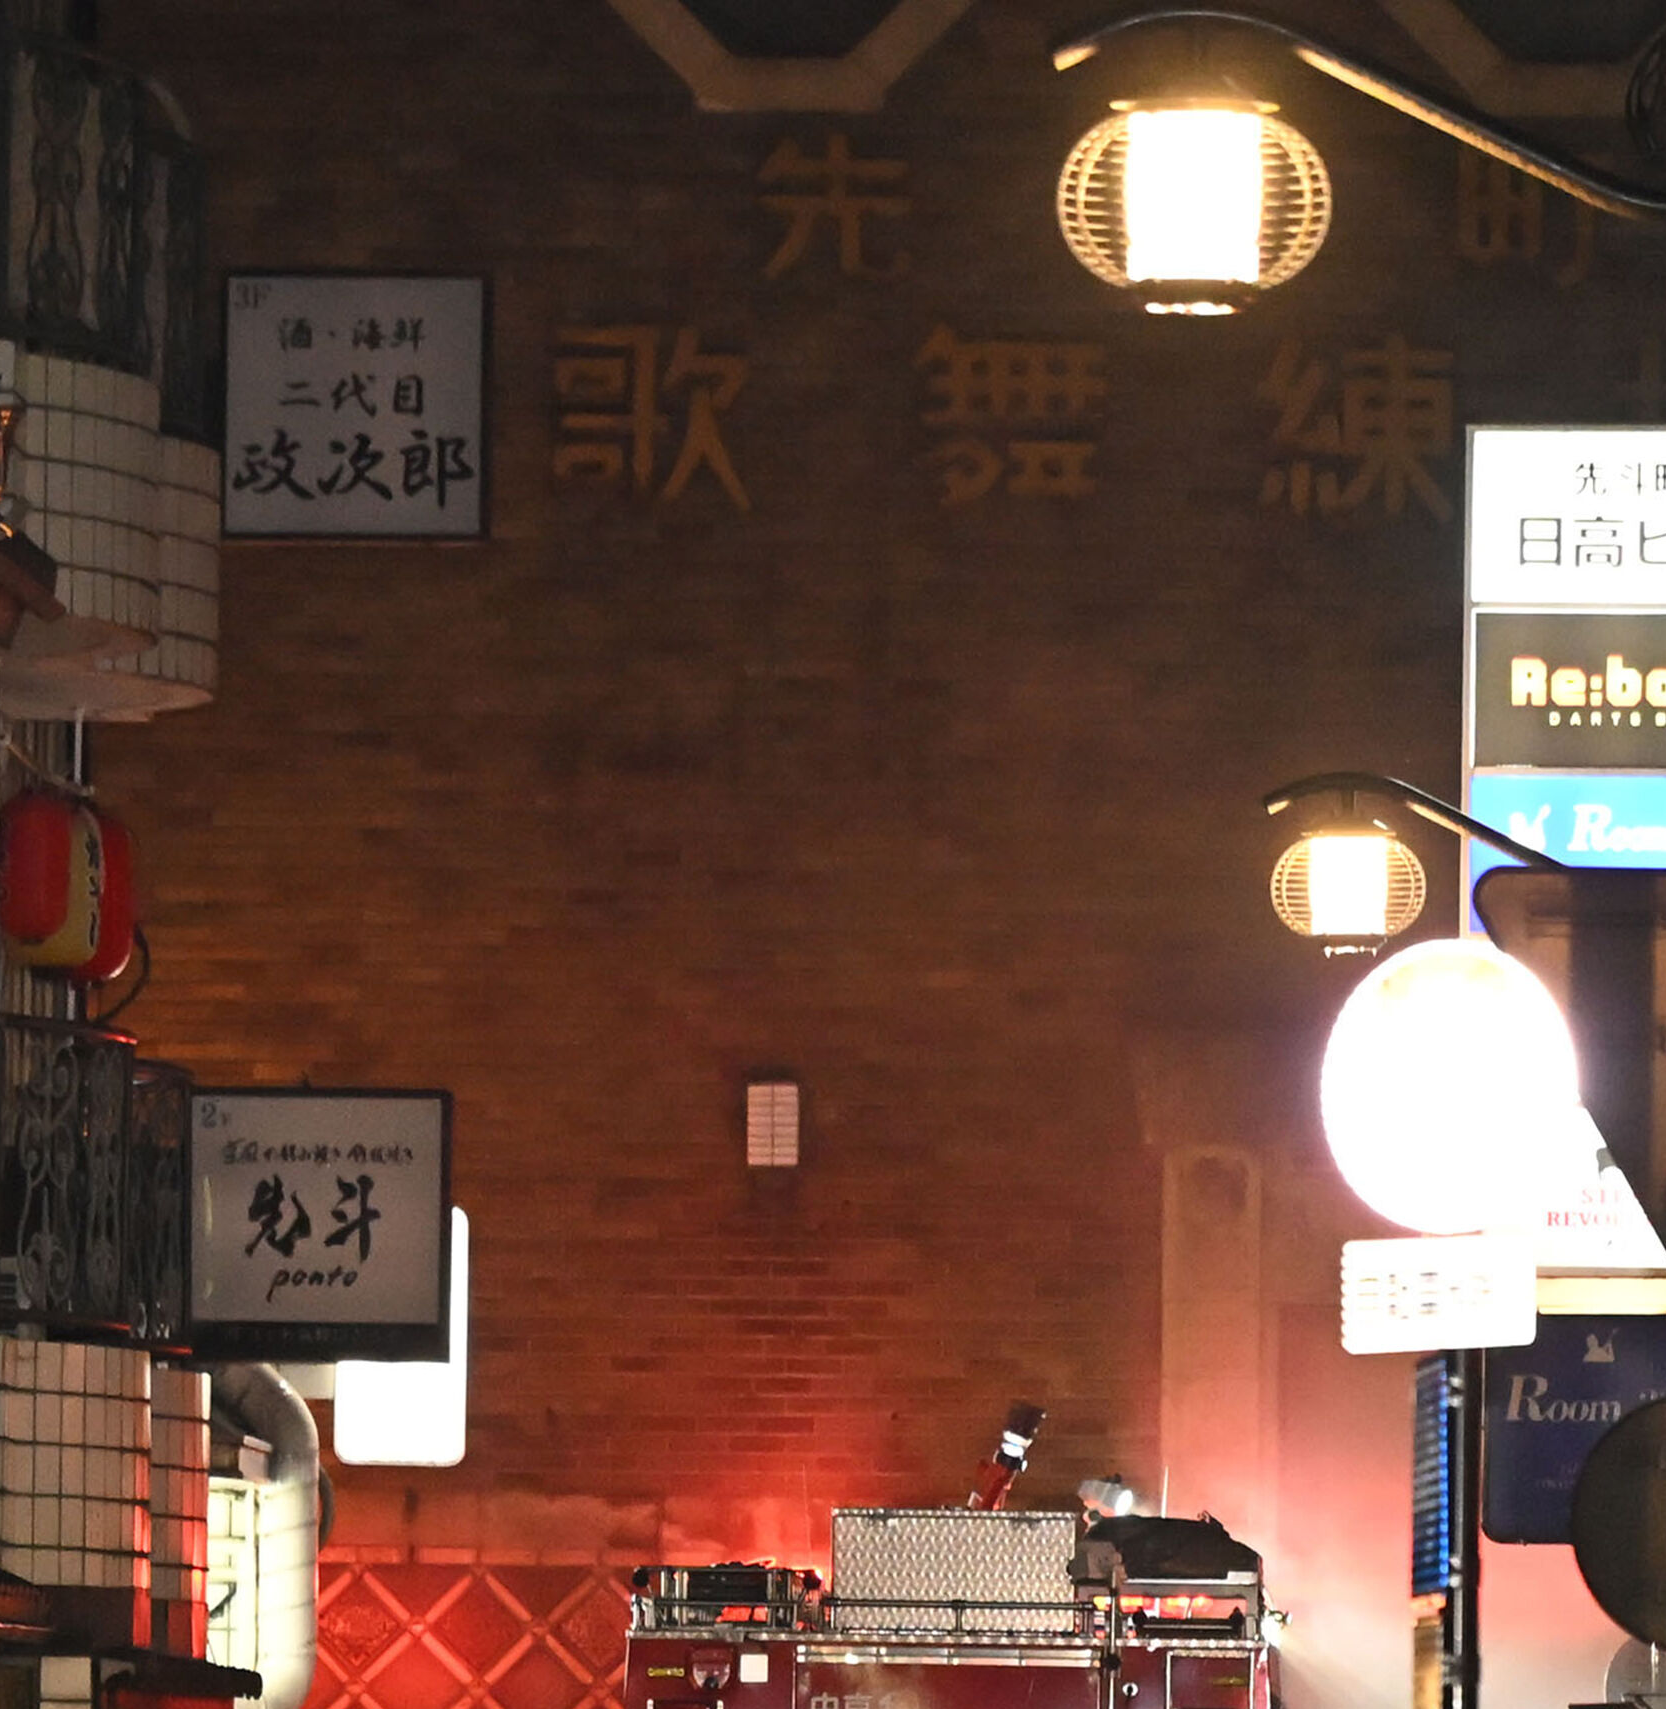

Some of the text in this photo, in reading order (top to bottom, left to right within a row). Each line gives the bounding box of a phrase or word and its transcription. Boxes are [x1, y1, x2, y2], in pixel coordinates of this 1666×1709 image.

[279, 373, 423, 416] 二代目
[233, 428, 475, 509] 政次郎
[244, 1174, 381, 1263] 先斗
[265, 1266, 359, 1302] ponto
[1505, 1374, 1622, 1423] Room
